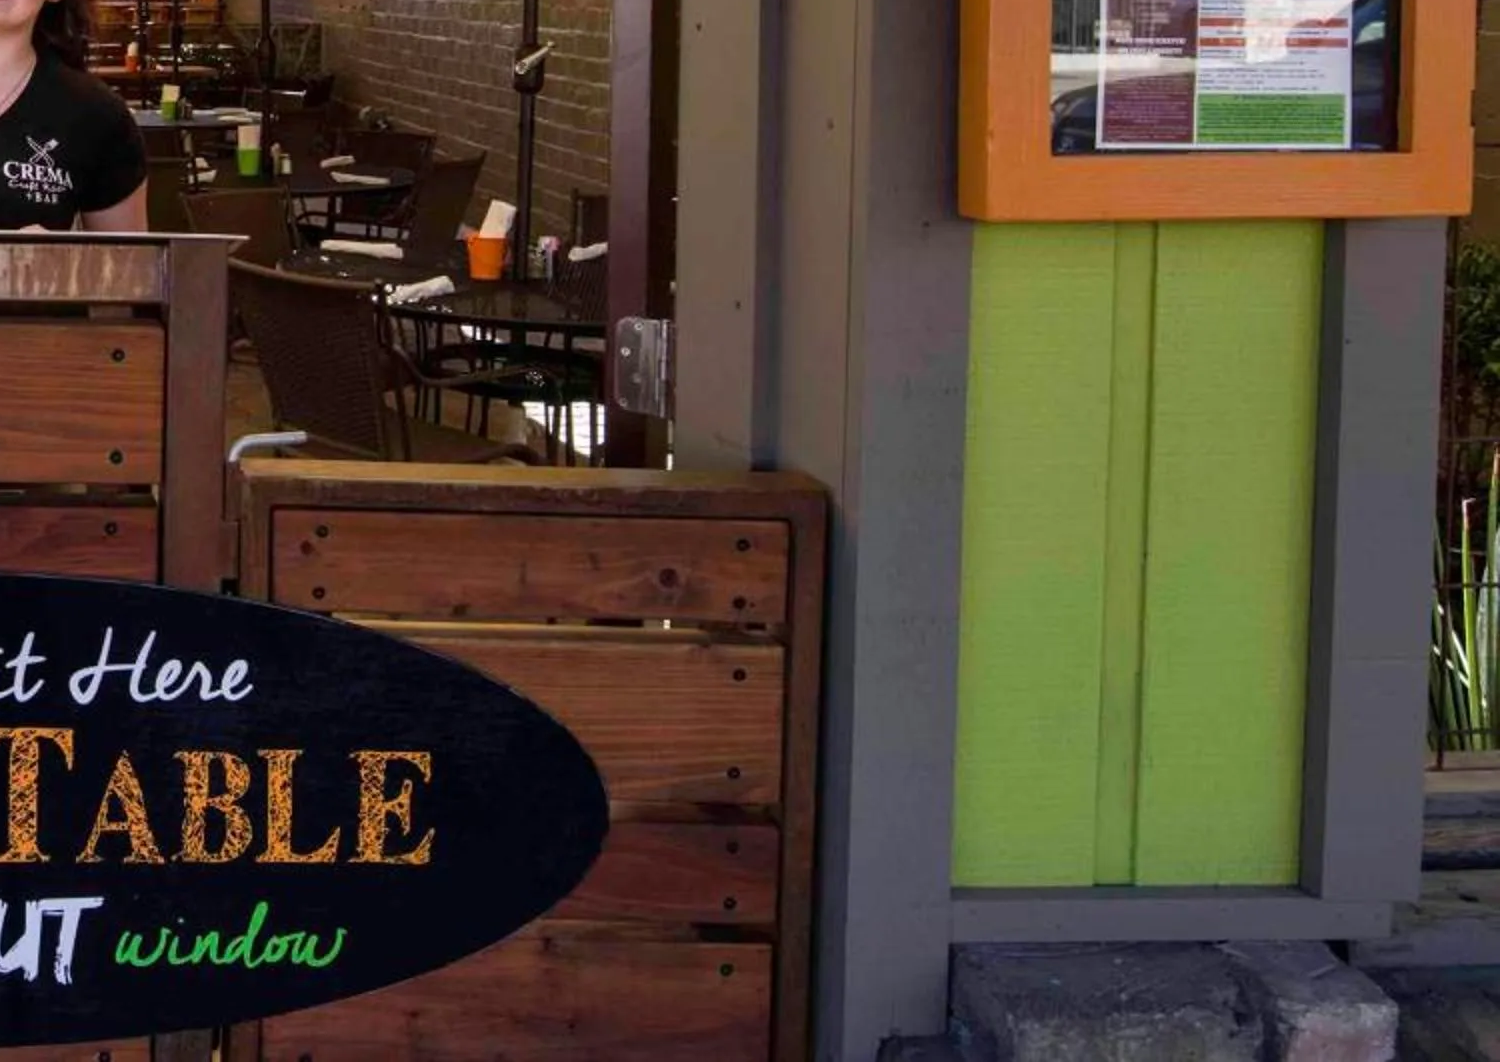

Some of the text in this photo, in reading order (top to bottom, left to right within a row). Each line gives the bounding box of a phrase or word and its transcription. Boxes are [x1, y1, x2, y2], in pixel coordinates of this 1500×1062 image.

[3, 161, 73, 190] CREMA
[69, 627, 253, 705] Here
[116, 902, 346, 967] window
